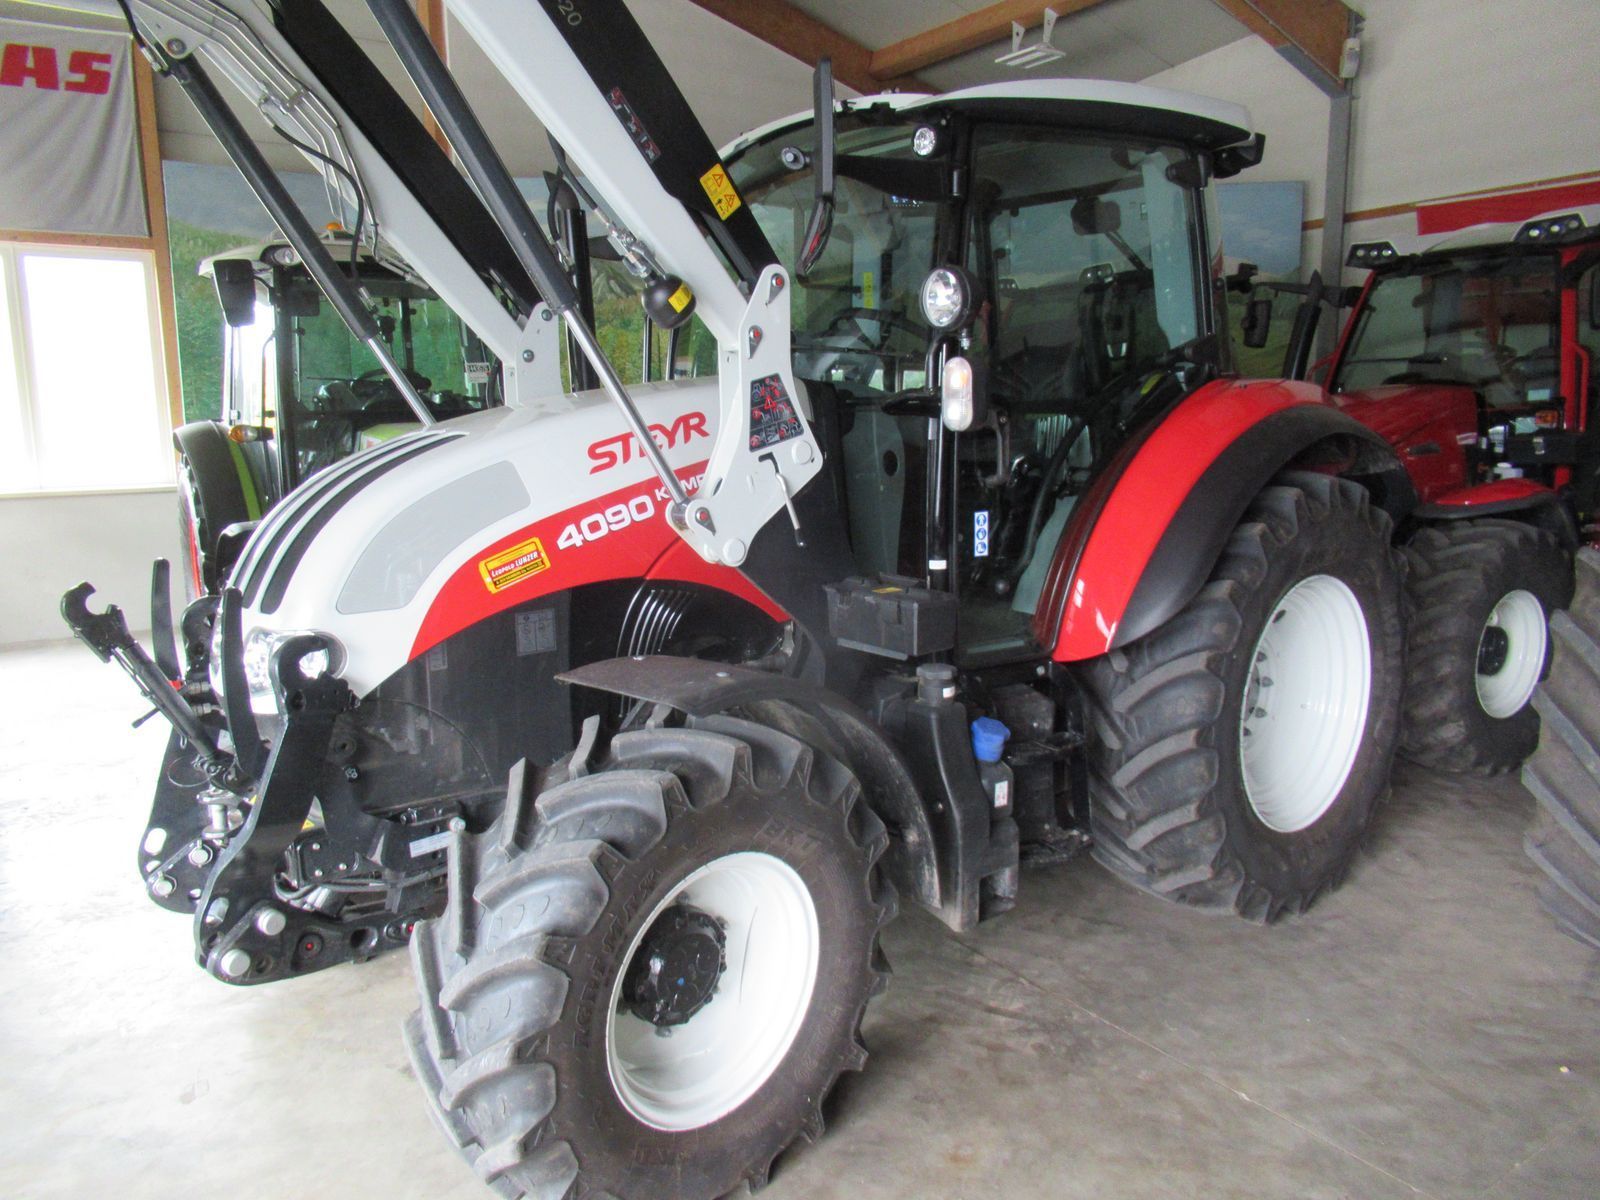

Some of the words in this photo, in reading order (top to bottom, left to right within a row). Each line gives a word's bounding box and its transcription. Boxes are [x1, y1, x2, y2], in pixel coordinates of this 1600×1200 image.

[0, 43, 112, 95] AS
[556, 494, 655, 550] 4090
[515, 551, 538, 567] LUNZER
